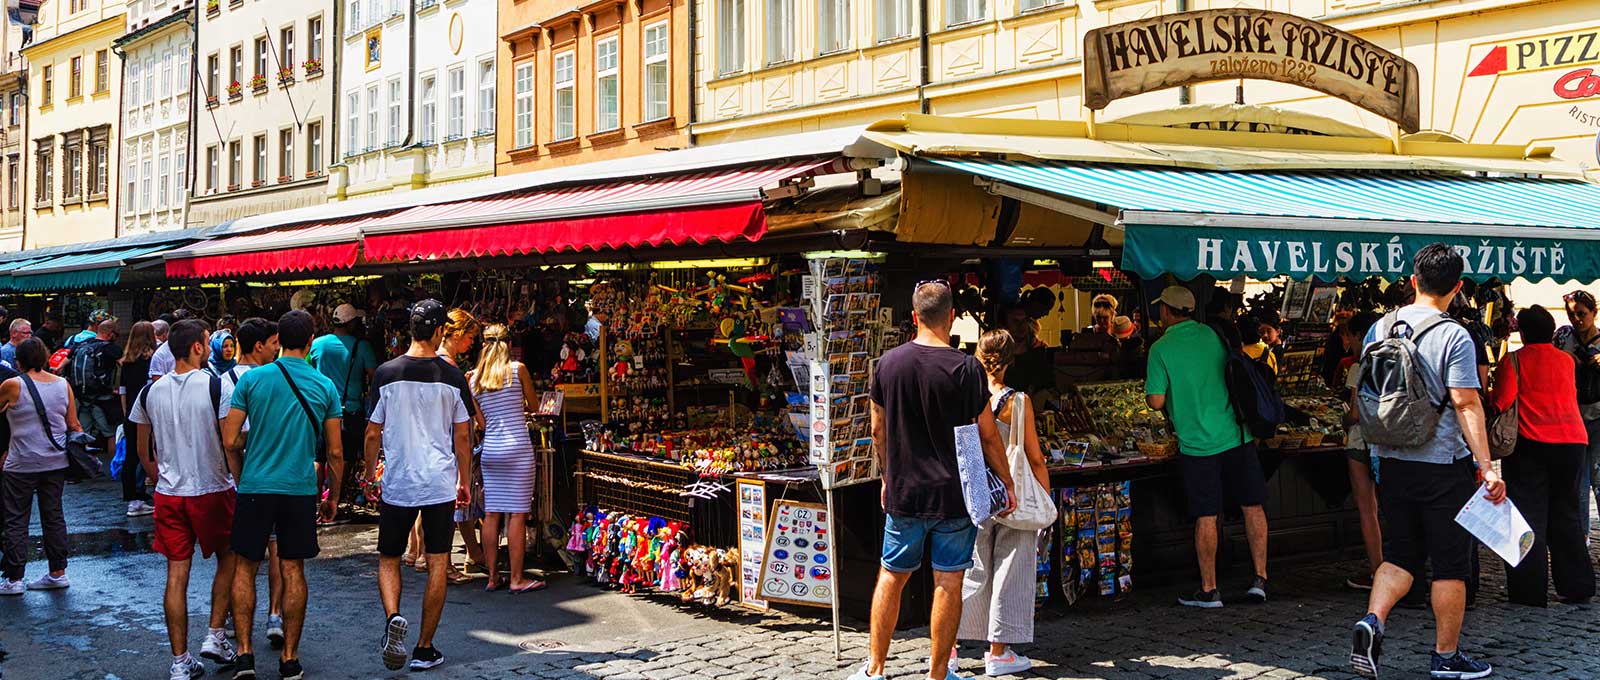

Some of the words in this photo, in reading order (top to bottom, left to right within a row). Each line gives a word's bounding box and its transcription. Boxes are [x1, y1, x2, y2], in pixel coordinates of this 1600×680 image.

[1104, 12, 1277, 72] HAVELSKÉ
[1282, 21, 1401, 97] TRŽIŠTĚ
[1210, 56, 1278, 75] založeno
[1280, 58, 1317, 84] 1232
[1197, 235, 1405, 273] HAVELSKÉ
[1453, 239, 1565, 275] RŽIŠTĚ
[797, 509, 807, 519] CZ
[775, 563, 784, 572] CZ
[767, 581, 784, 593] CZ
[793, 584, 806, 593] CZ
